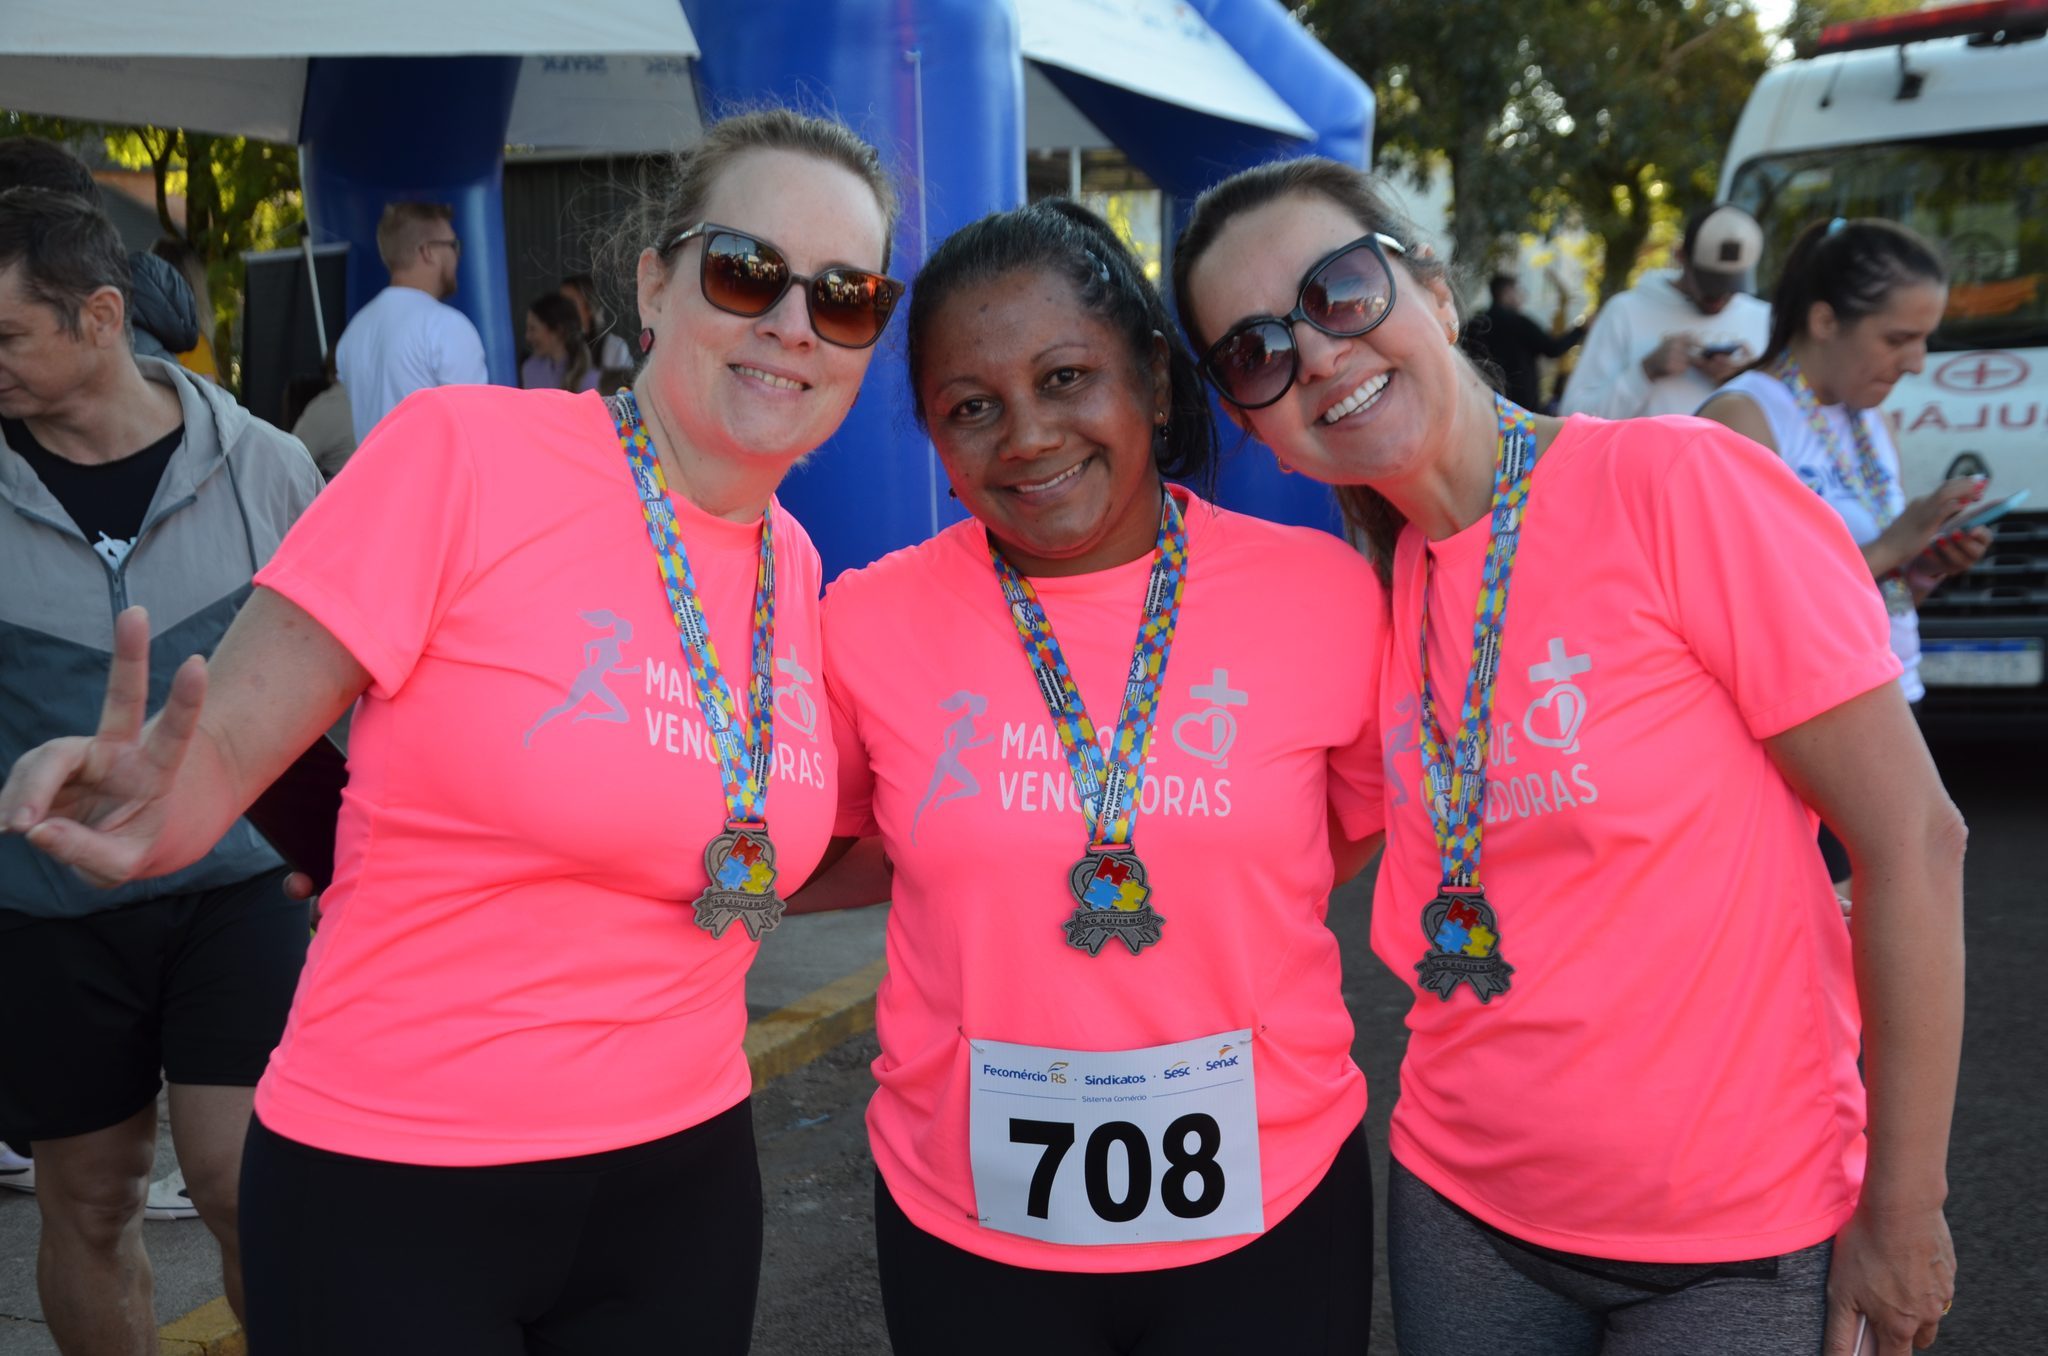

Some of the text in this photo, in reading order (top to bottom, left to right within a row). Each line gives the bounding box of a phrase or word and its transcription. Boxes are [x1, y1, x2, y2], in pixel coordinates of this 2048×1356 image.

[646, 657, 702, 711] MAI
[1001, 722, 1068, 761] MAI
[1490, 722, 1517, 766] UE
[1101, 917, 1142, 925] AUTISMO
[983, 1055, 1239, 1086] Fecomércio RS Sindicatos Sesc Senac
[1082, 1094, 1147, 1103] Sistema Comércio
[1009, 1112, 1226, 1223] 708
